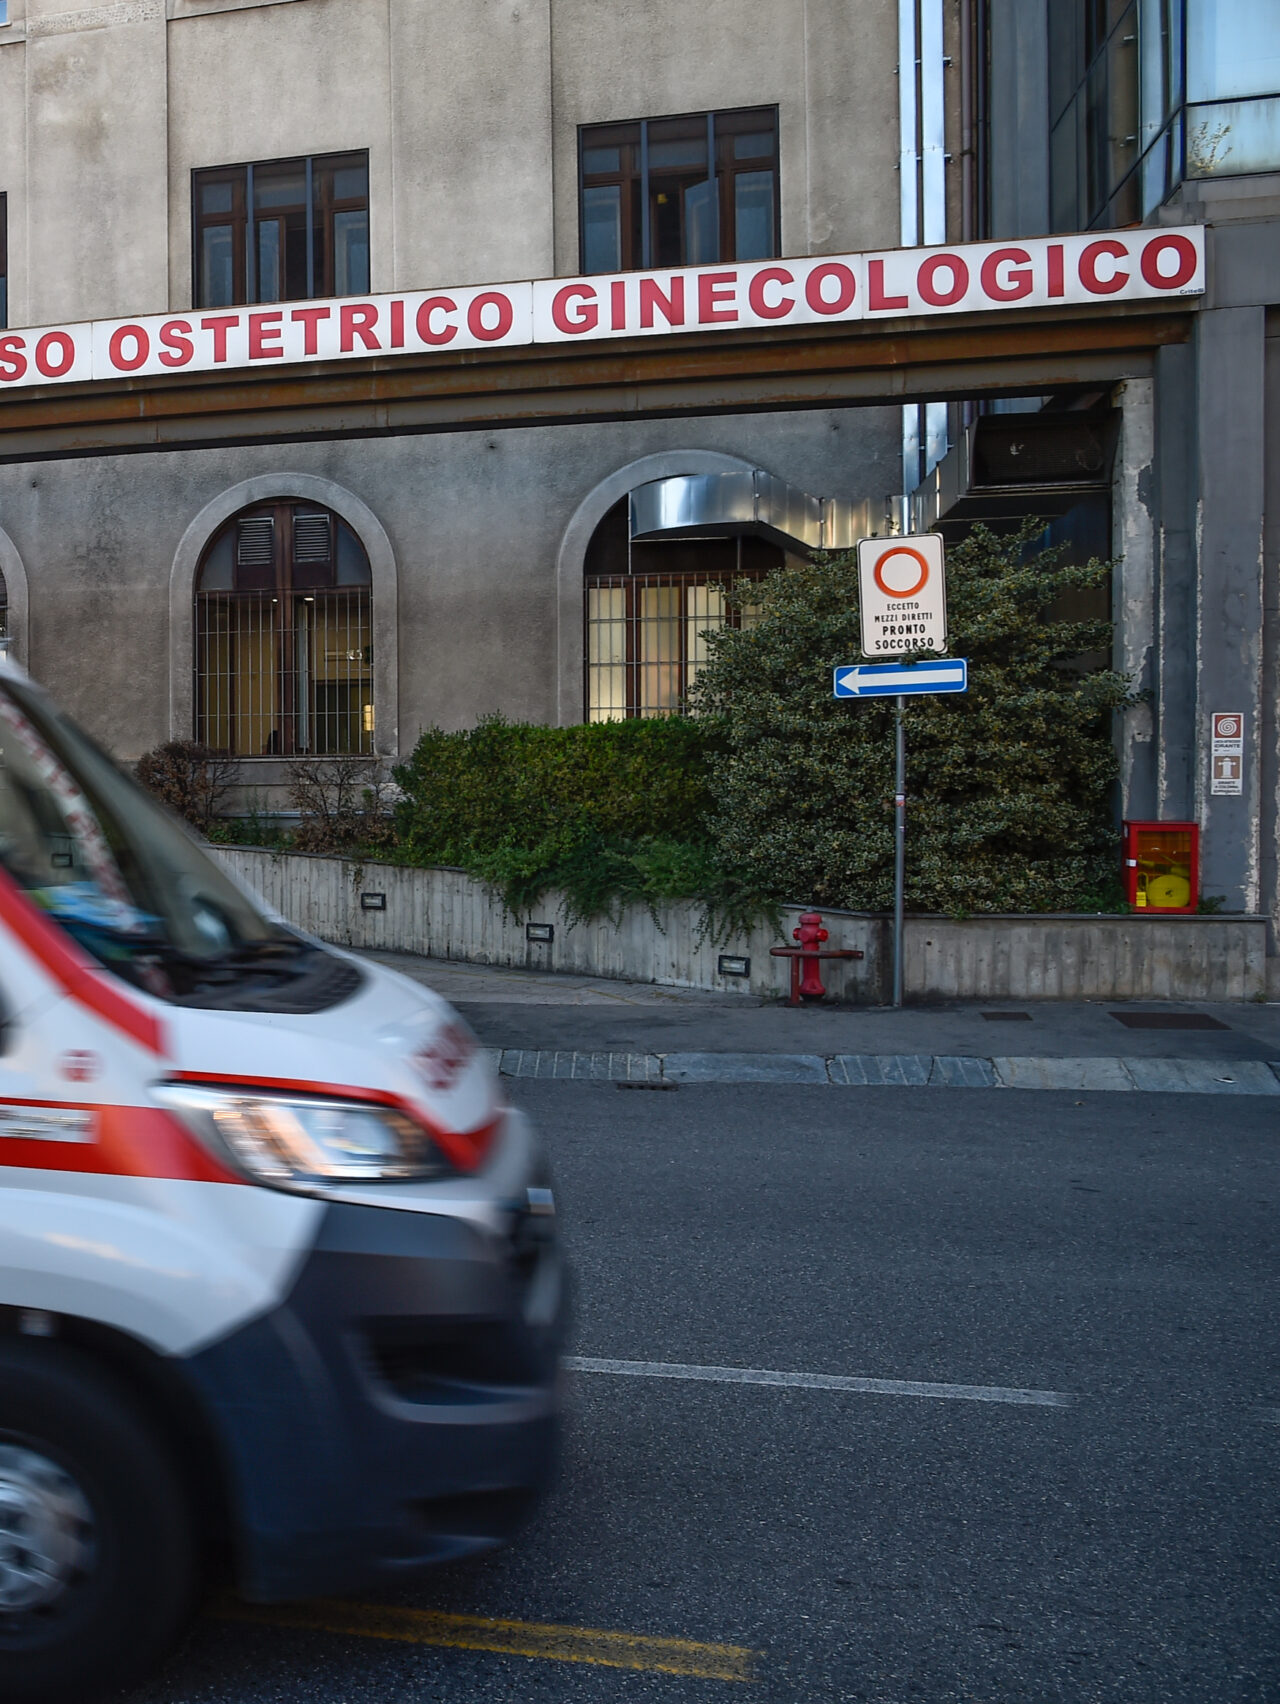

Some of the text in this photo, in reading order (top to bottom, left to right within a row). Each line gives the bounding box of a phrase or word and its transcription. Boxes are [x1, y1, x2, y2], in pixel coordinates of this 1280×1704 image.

[109, 292, 514, 371] OSTETRICO
[551, 234, 1197, 335] GINECOLOGICO
[887, 602, 919, 611] ECCETTO
[874, 612, 933, 623] MEZZI DIRETTI
[882, 624, 926, 636] PRONTO
[875, 637, 934, 650] SOCCORSO
